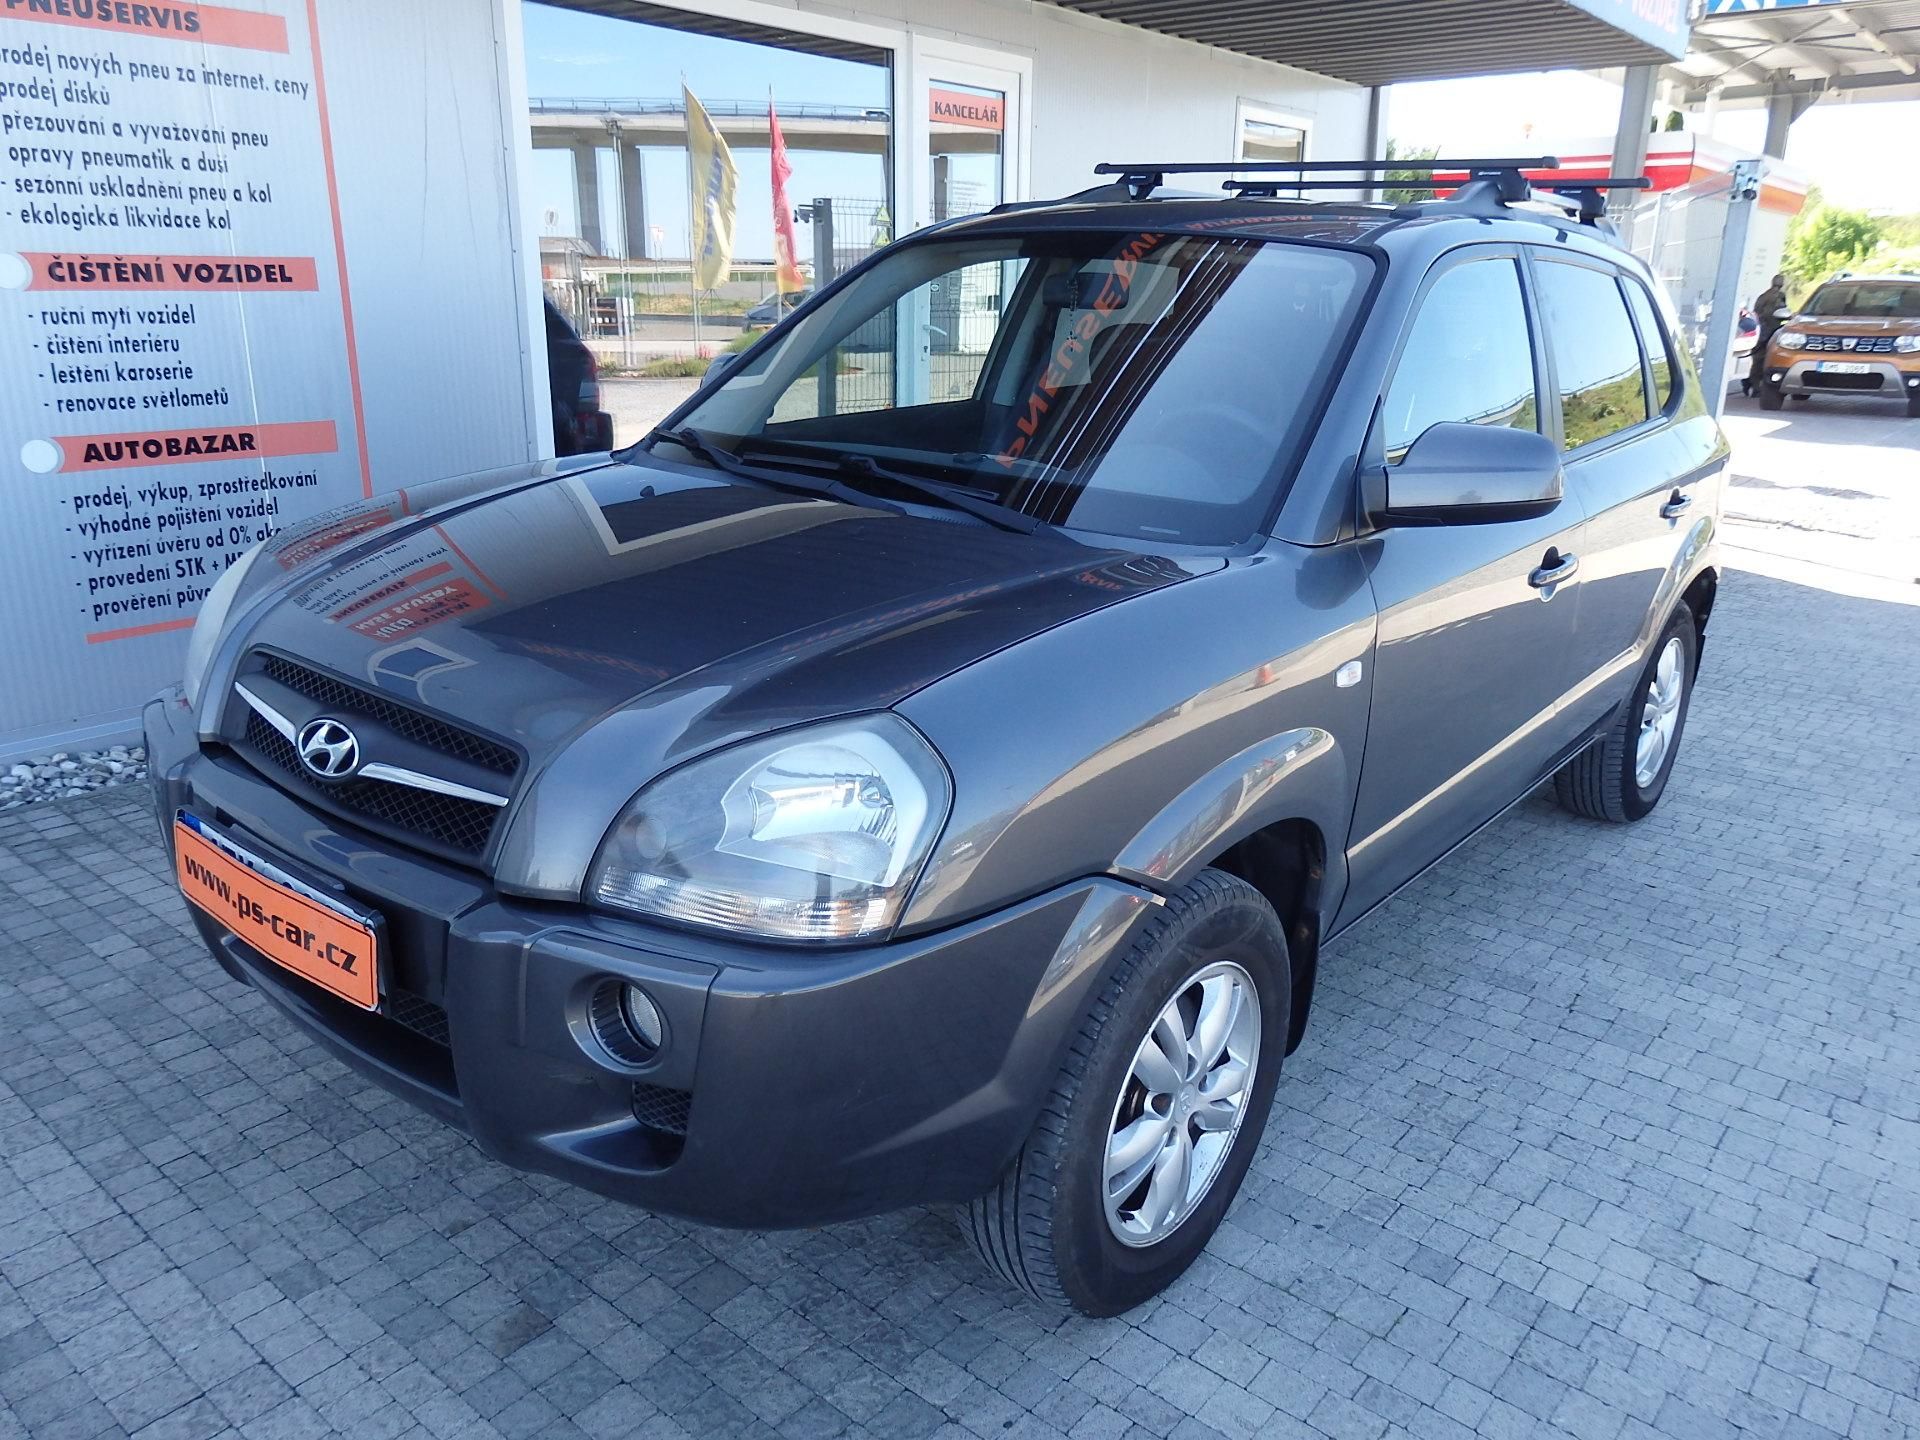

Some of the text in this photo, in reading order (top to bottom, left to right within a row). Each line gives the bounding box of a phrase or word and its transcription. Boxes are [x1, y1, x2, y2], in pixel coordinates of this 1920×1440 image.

[0, 42, 309, 101] rodej nových pneu za internet. ceny
[63, 80, 110, 106] disků
[934, 101, 998, 123] KANCELÁŘ
[2, 110, 269, 150] přezouvání a vyvažování pneu
[9, 146, 228, 174] opravy pneumatik a duší
[15, 174, 83, 196] sezónní
[89, 174, 182, 200] uskladnění
[189, 186, 226, 205] pneu
[233, 188, 242, 202] a
[247, 182, 272, 203] kol
[21, 201, 119, 231] ekologická
[124, 205, 201, 229] likvidace
[206, 208, 231, 230] kol
[48, 253, 293, 284] ČIŠTĚNÍ VOZIDEL
[41, 306, 86, 325] ruční
[92, 305, 132, 330] mytí
[137, 304, 196, 325] vozidel
[47, 333, 103, 355] čištění
[107, 333, 180, 354] interiéru
[51, 362, 110, 384] leštění
[115, 360, 193, 382] karoserie
[57, 396, 136, 413] renovace
[143, 387, 229, 409] světlometů
[83, 432, 256, 463] AUTOBAZAR
[74, 485, 132, 514] prodej,
[138, 481, 193, 507] výkup,
[198, 469, 318, 500] zprostředkování
[79, 511, 151, 541] výhodné
[157, 504, 221, 533] pojištění
[226, 496, 279, 520] vozidel
[83, 539, 151, 567] vyřízení
[157, 536, 200, 554] úvěru
[206, 528, 224, 548] od
[229, 525, 251, 545] 0%
[89, 563, 170, 595] provedení
[175, 557, 206, 579] STK
[93, 589, 172, 622] prověření
[184, 855, 358, 976] www.ps-car.cz
